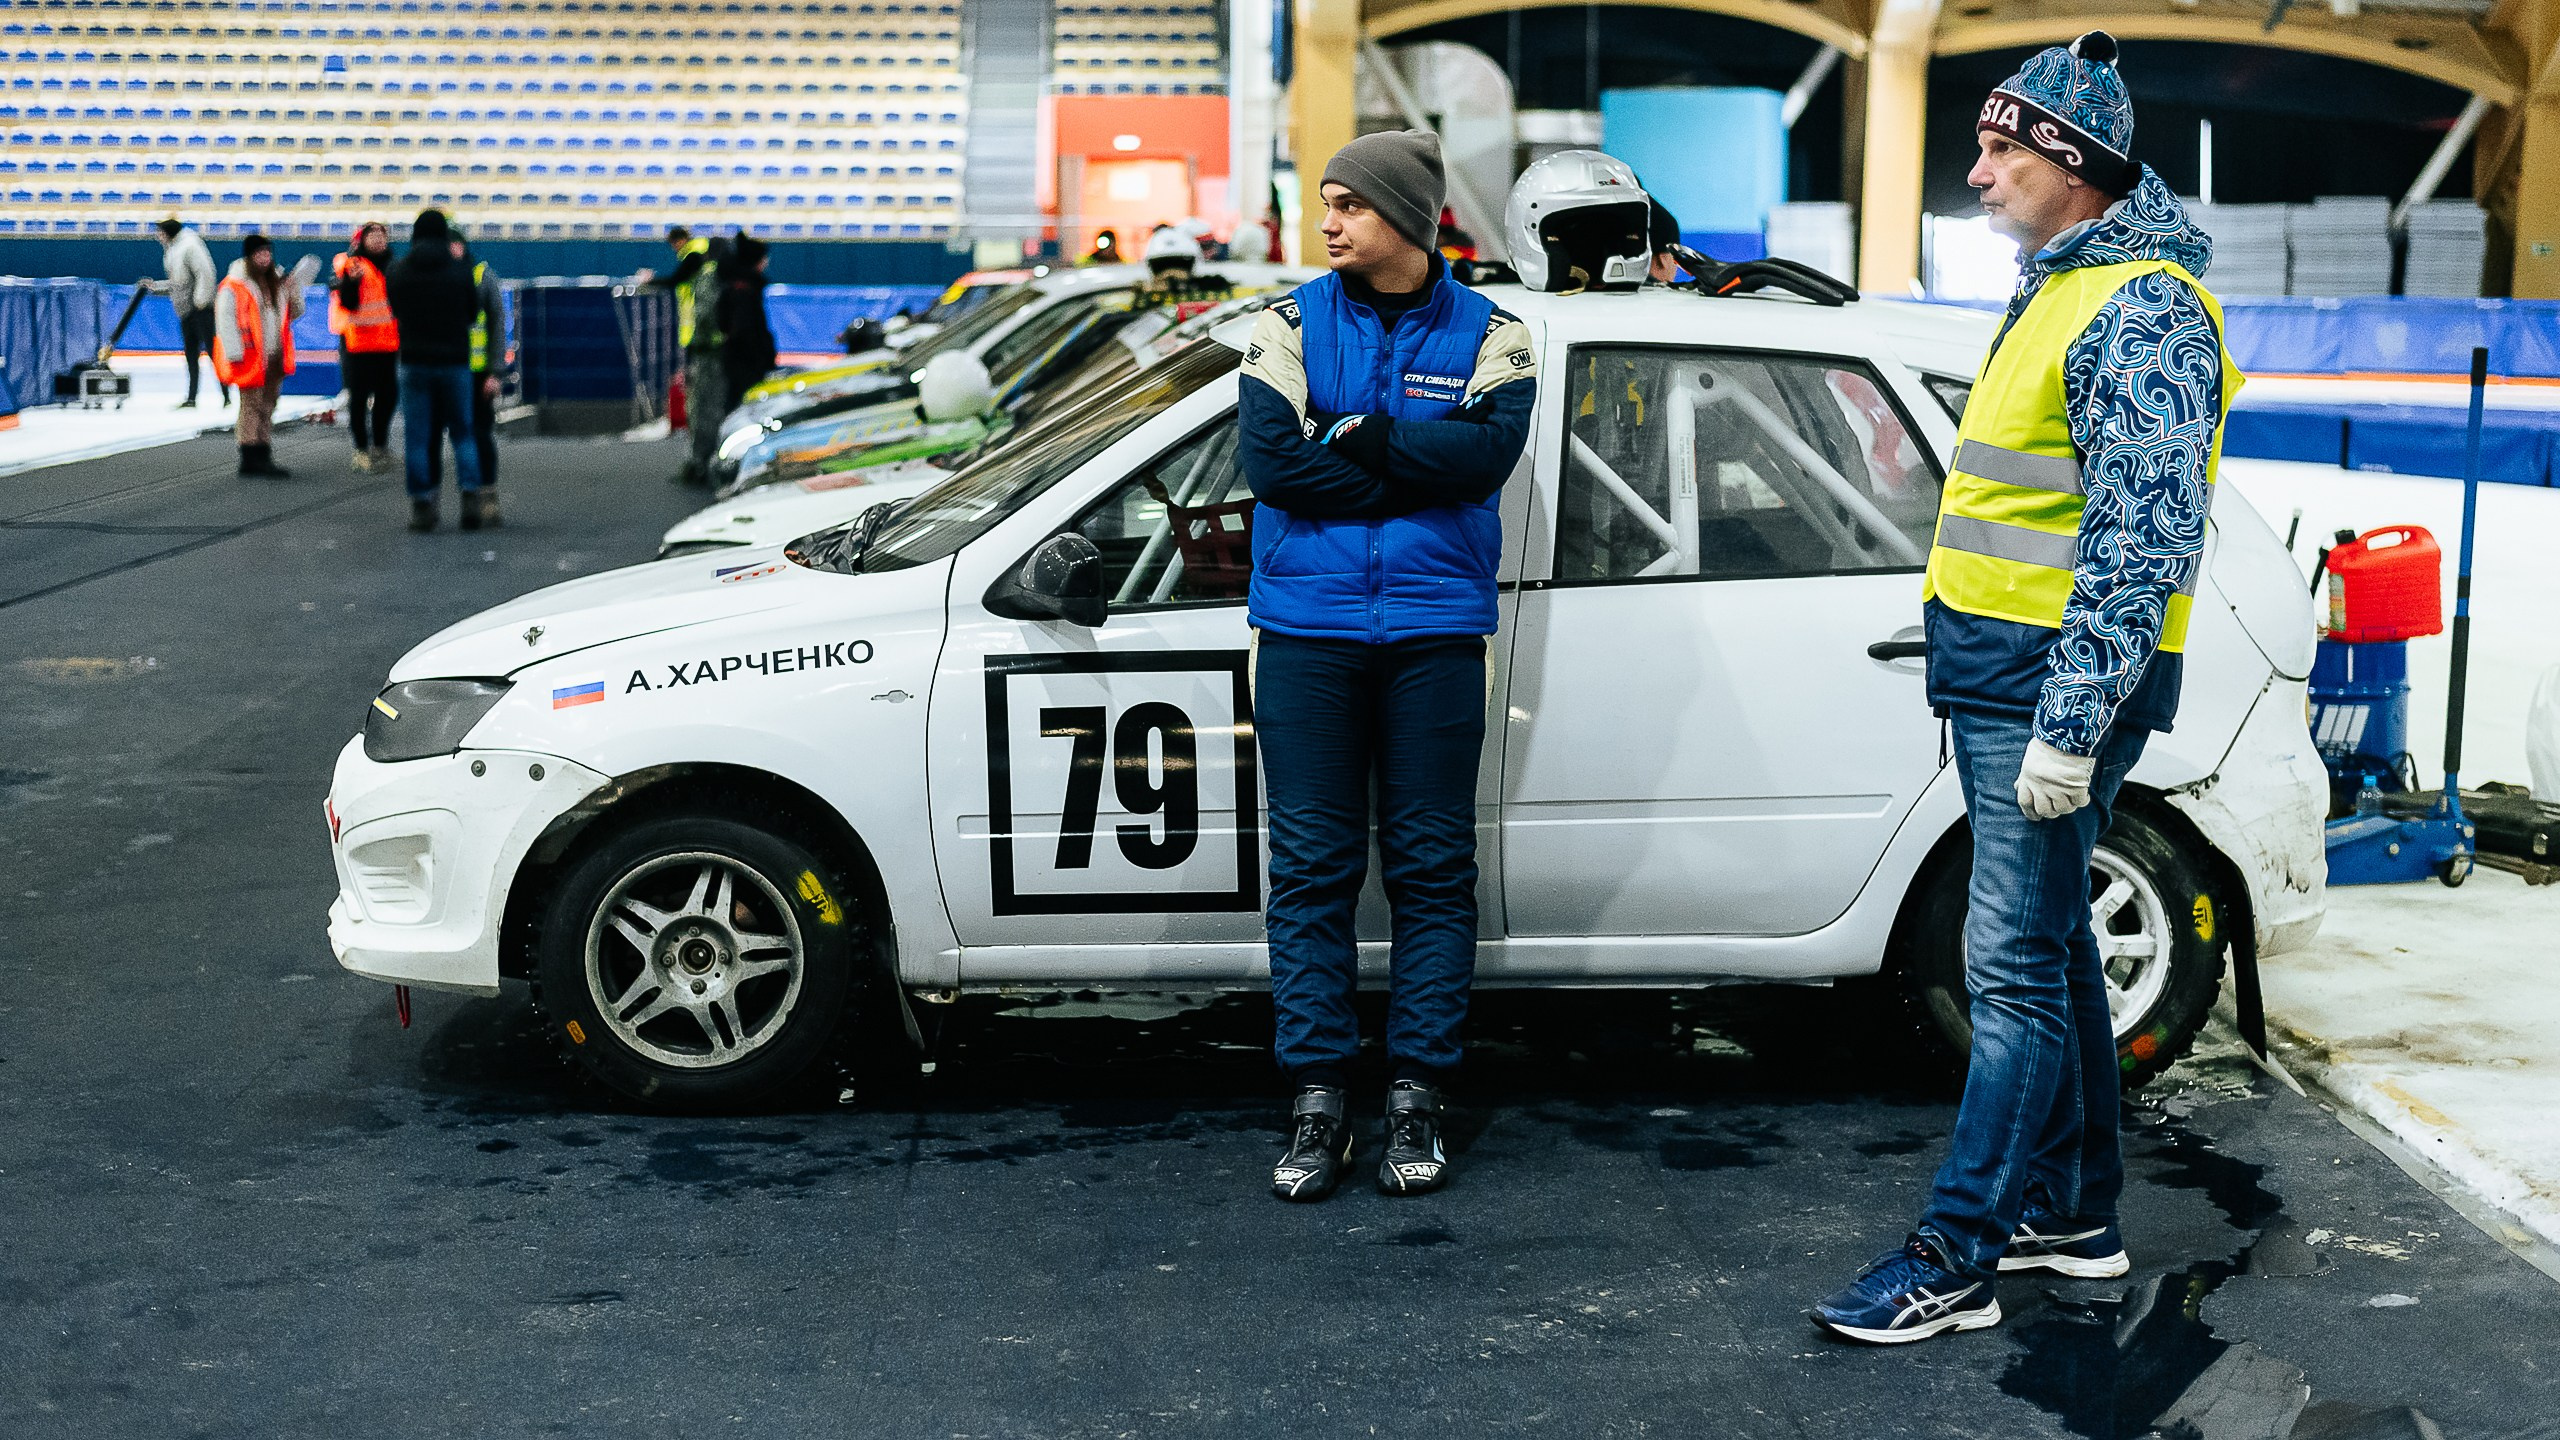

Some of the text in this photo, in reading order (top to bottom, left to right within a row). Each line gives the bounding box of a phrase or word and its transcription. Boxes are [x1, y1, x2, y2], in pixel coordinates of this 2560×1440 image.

[1246, 346, 1262, 362] MP
[1509, 351, 1532, 367] OMP
[1424, 375, 1466, 389] СИБАДИ
[625, 639, 875, 695] А.ХАРЧЕНКО
[1039, 701, 1199, 870] 79
[1400, 1165, 1440, 1178] OMP
